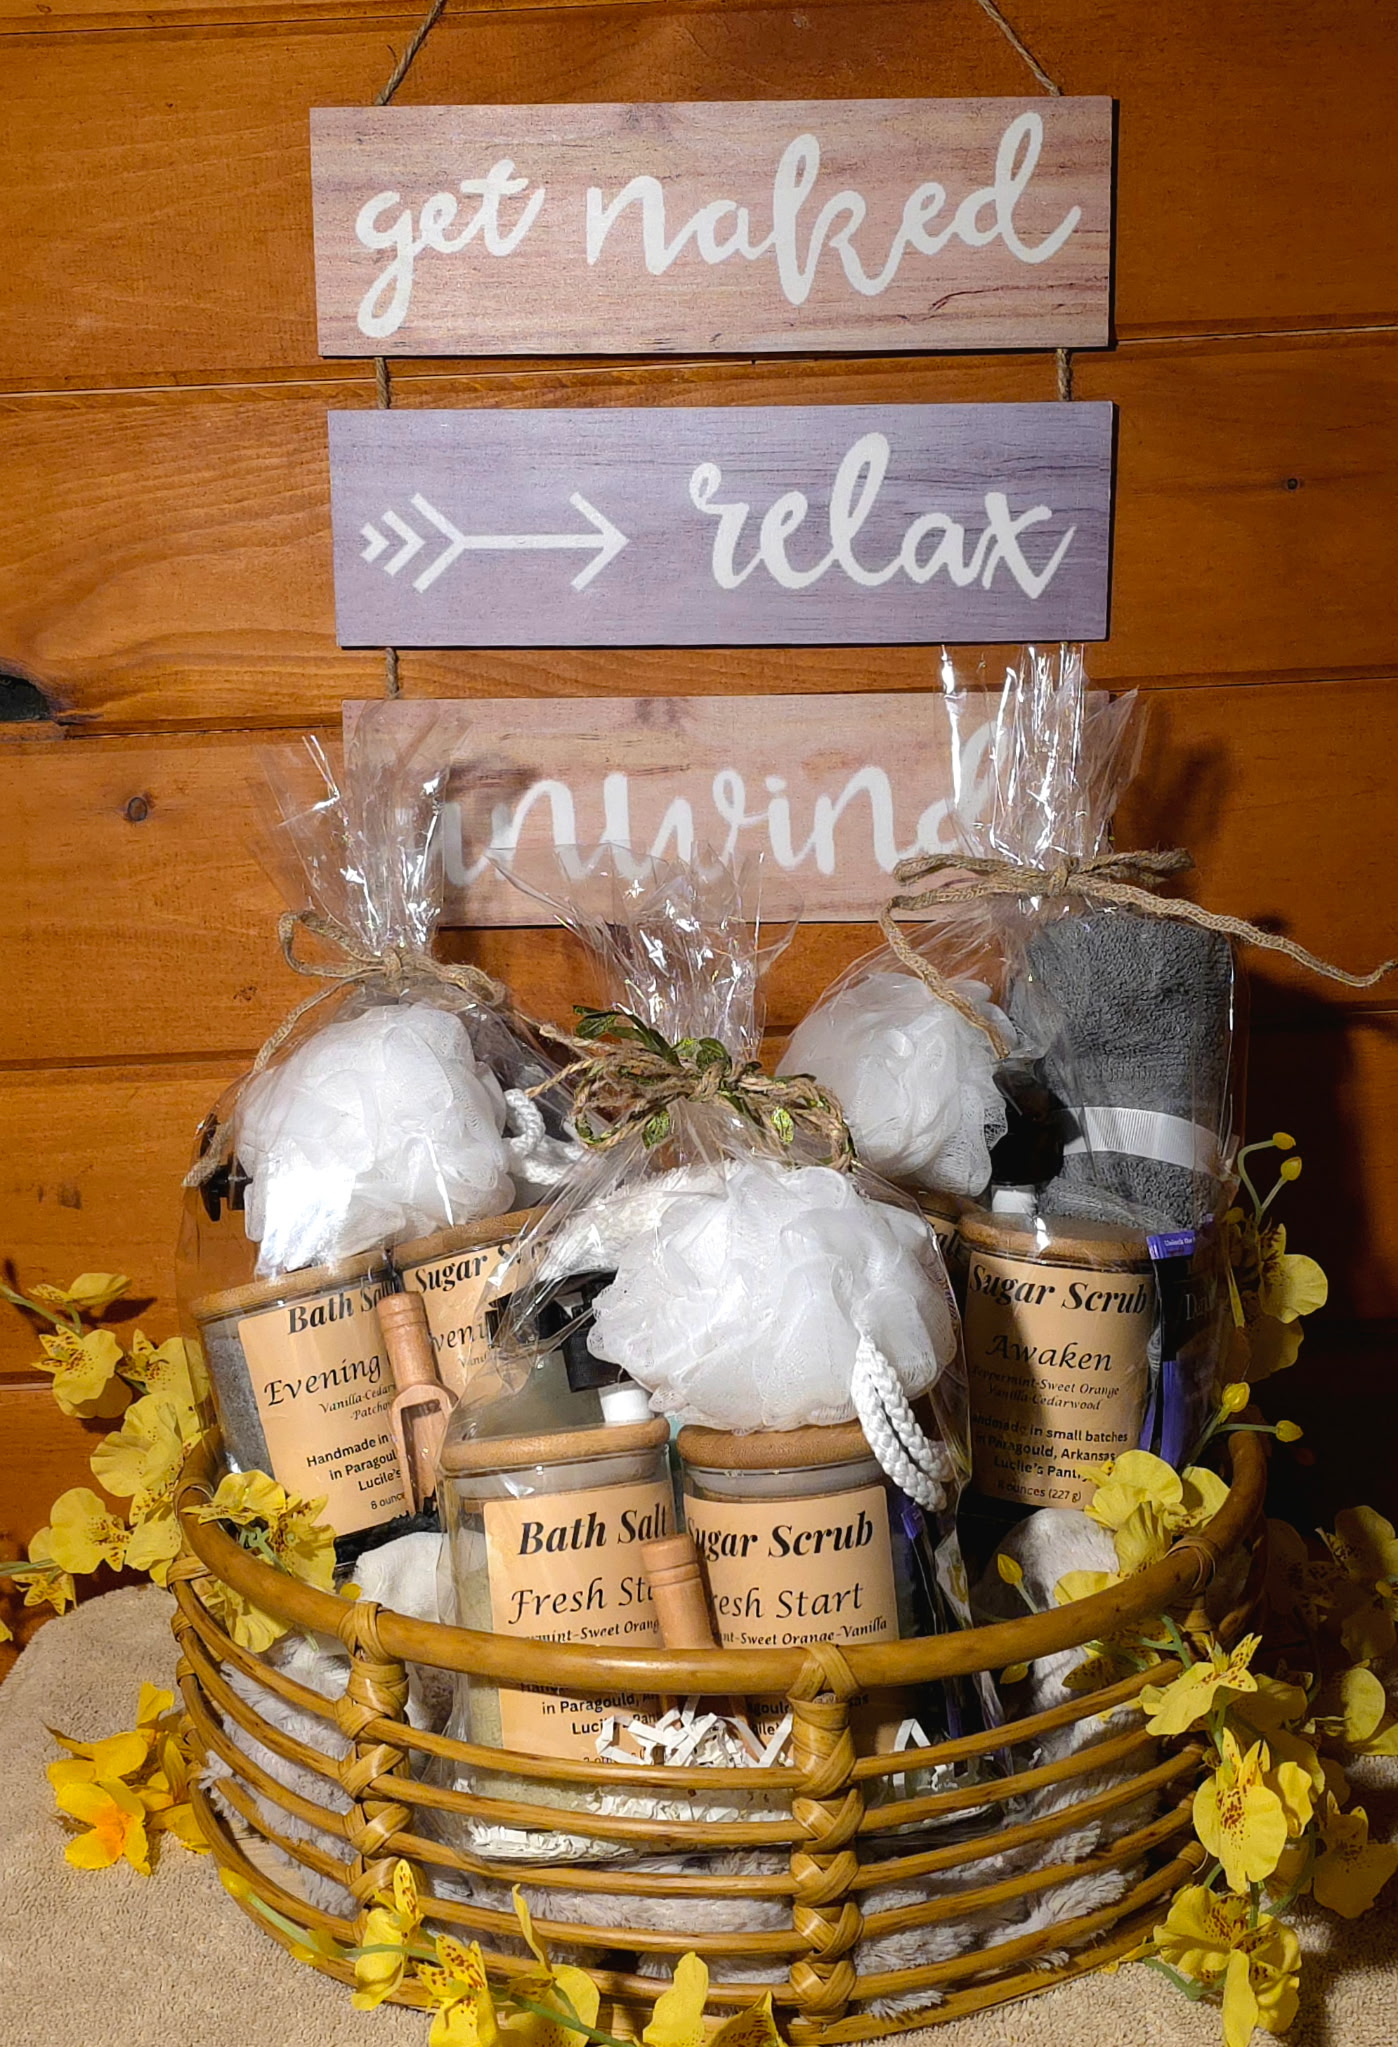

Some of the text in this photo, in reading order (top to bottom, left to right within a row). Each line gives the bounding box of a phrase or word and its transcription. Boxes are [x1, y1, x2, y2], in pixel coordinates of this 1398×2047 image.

[355, 111, 1082, 338] get naked
[689, 432, 1077, 600] relax
[415, 1255, 488, 1294] Sugar
[969, 1264, 1056, 1306] Sugar
[1061, 1281, 1148, 1315] Scrub
[288, 1292, 355, 1335] Bath
[985, 1334, 1112, 1372] Awaken
[264, 1354, 381, 1407] Evening
[1079, 1383, 1120, 1399] Orange
[306, 1433, 389, 1467] Handmade in
[1030, 1425, 1043, 1436] in
[1046, 1428, 1082, 1442] small
[1085, 1430, 1129, 1443] batches
[329, 1449, 398, 1481] in Paragoul
[358, 1468, 402, 1492] Lucile's
[370, 1500, 378, 1510] 8
[1006, 1482, 1046, 1498] ounces
[1048, 1488, 1070, 1500] (227
[518, 1502, 667, 1556] Bath Salt
[768, 1510, 874, 1558] Scrub
[508, 1576, 608, 1625] Fresh
[775, 1582, 864, 1619] Start
[623, 1619, 660, 1634] Orang
[541, 1701, 556, 1715] in
[560, 1692, 640, 1714] Paragould,
